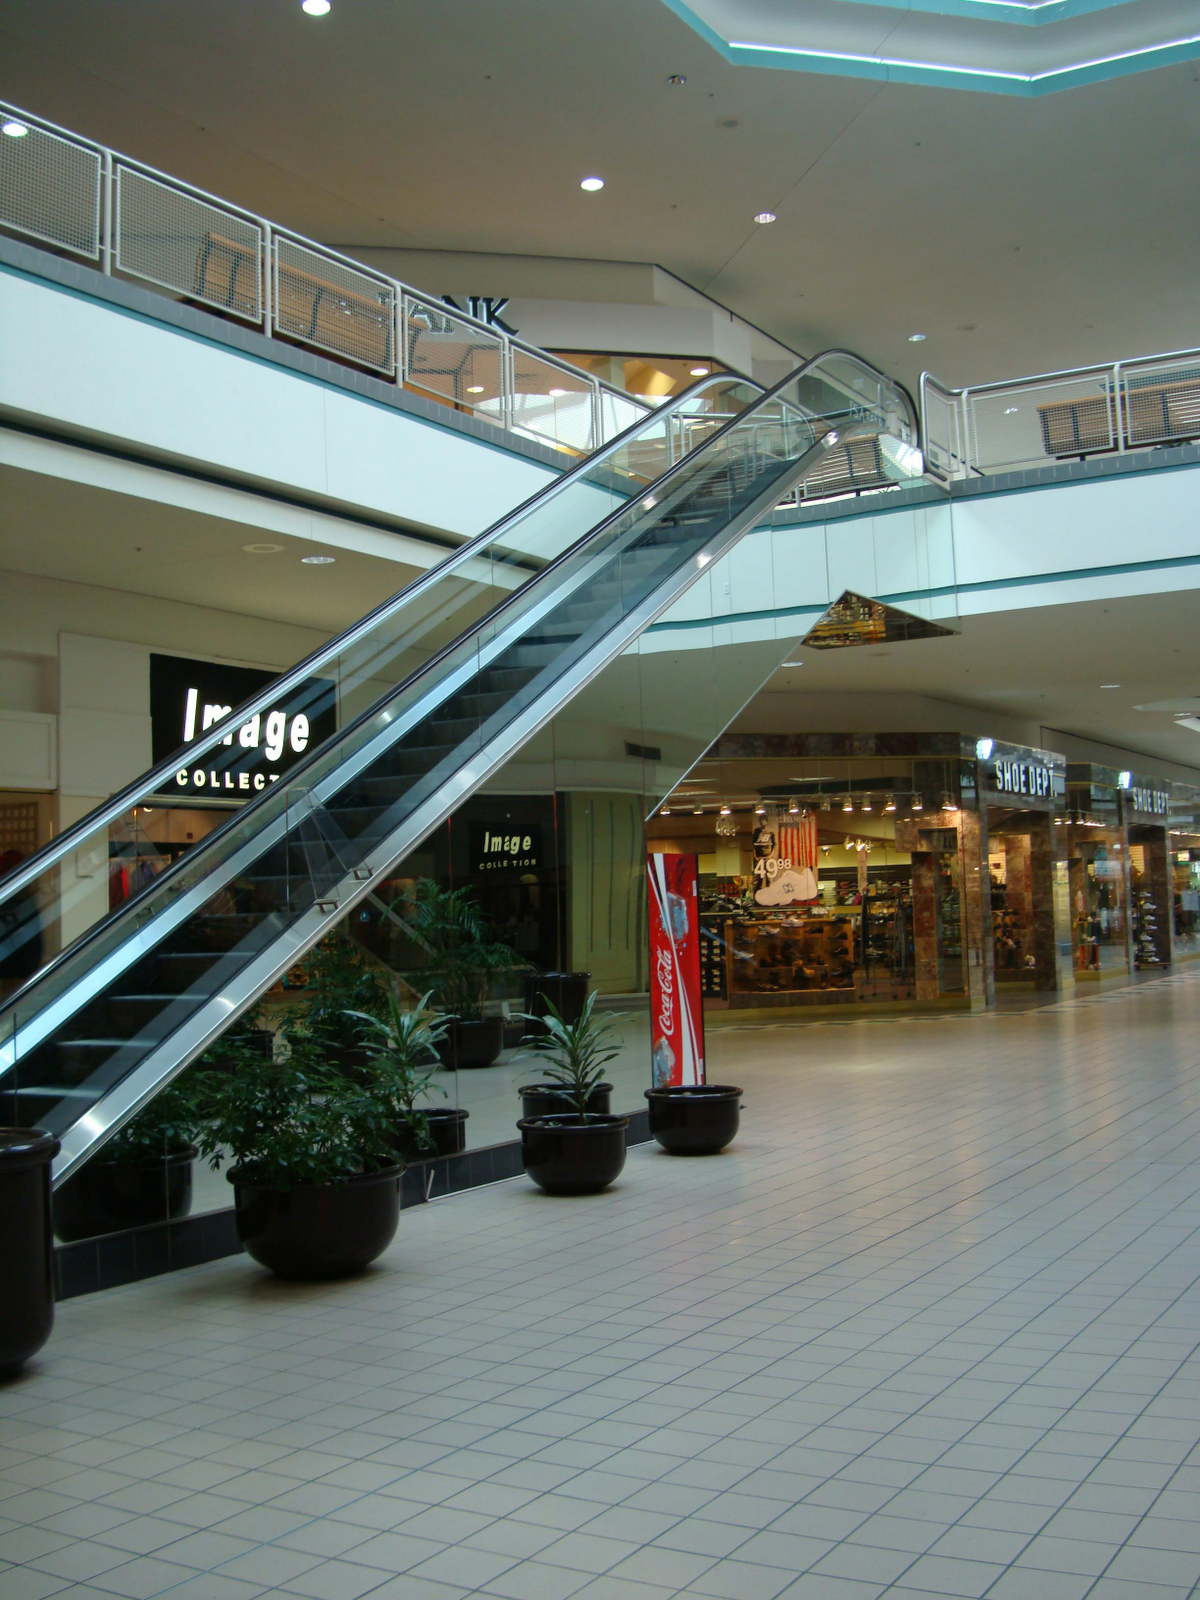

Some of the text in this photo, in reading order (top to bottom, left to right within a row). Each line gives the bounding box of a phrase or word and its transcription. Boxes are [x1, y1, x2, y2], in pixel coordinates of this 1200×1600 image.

[184, 688, 309, 762] Image
[995, 759, 1026, 793] SHOE
[1133, 787, 1152, 812] SHOE
[484, 831, 532, 855] Image
[479, 858, 537, 870] COLLETION
